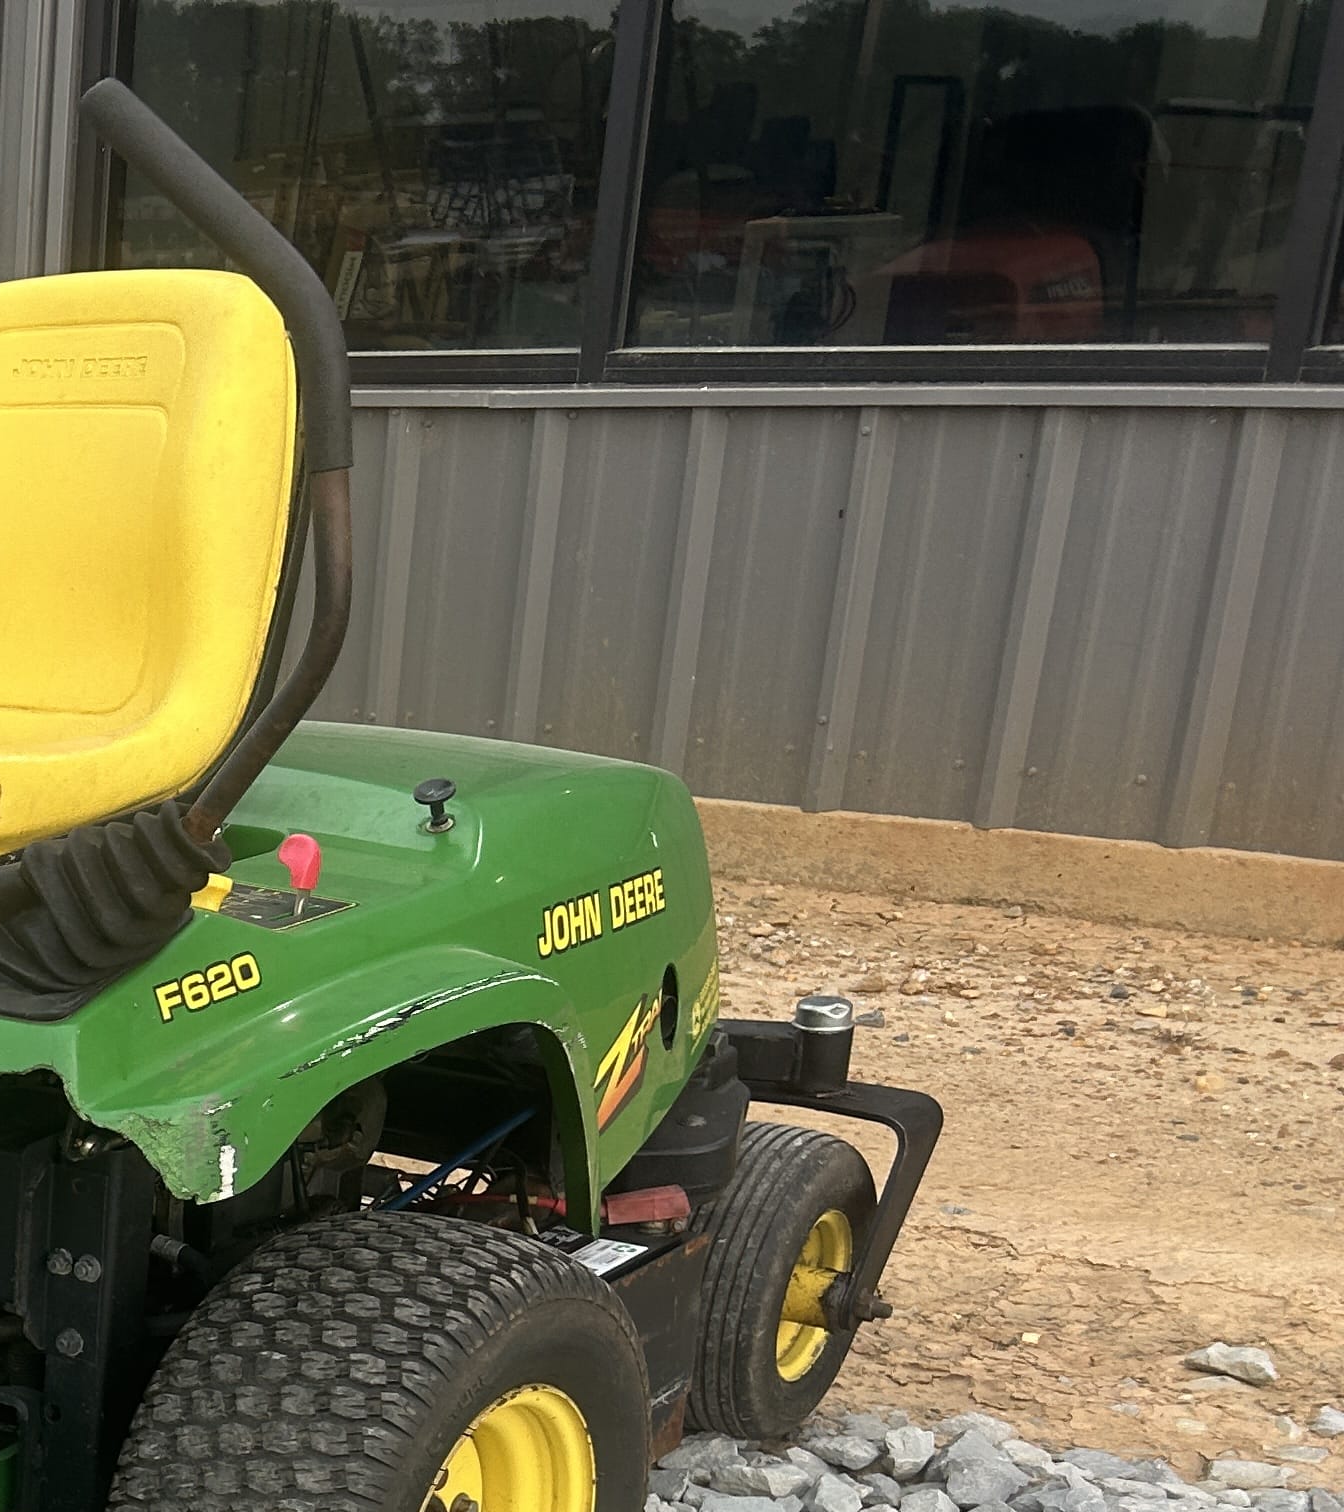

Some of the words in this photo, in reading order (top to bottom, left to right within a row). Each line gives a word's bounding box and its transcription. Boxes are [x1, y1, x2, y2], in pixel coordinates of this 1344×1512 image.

[12, 357, 75, 379] JOHN
[80, 355, 148, 378] DEERE
[538, 891, 602, 957] JOHN
[609, 867, 665, 930] DEERE
[154, 952, 261, 1022] F620
